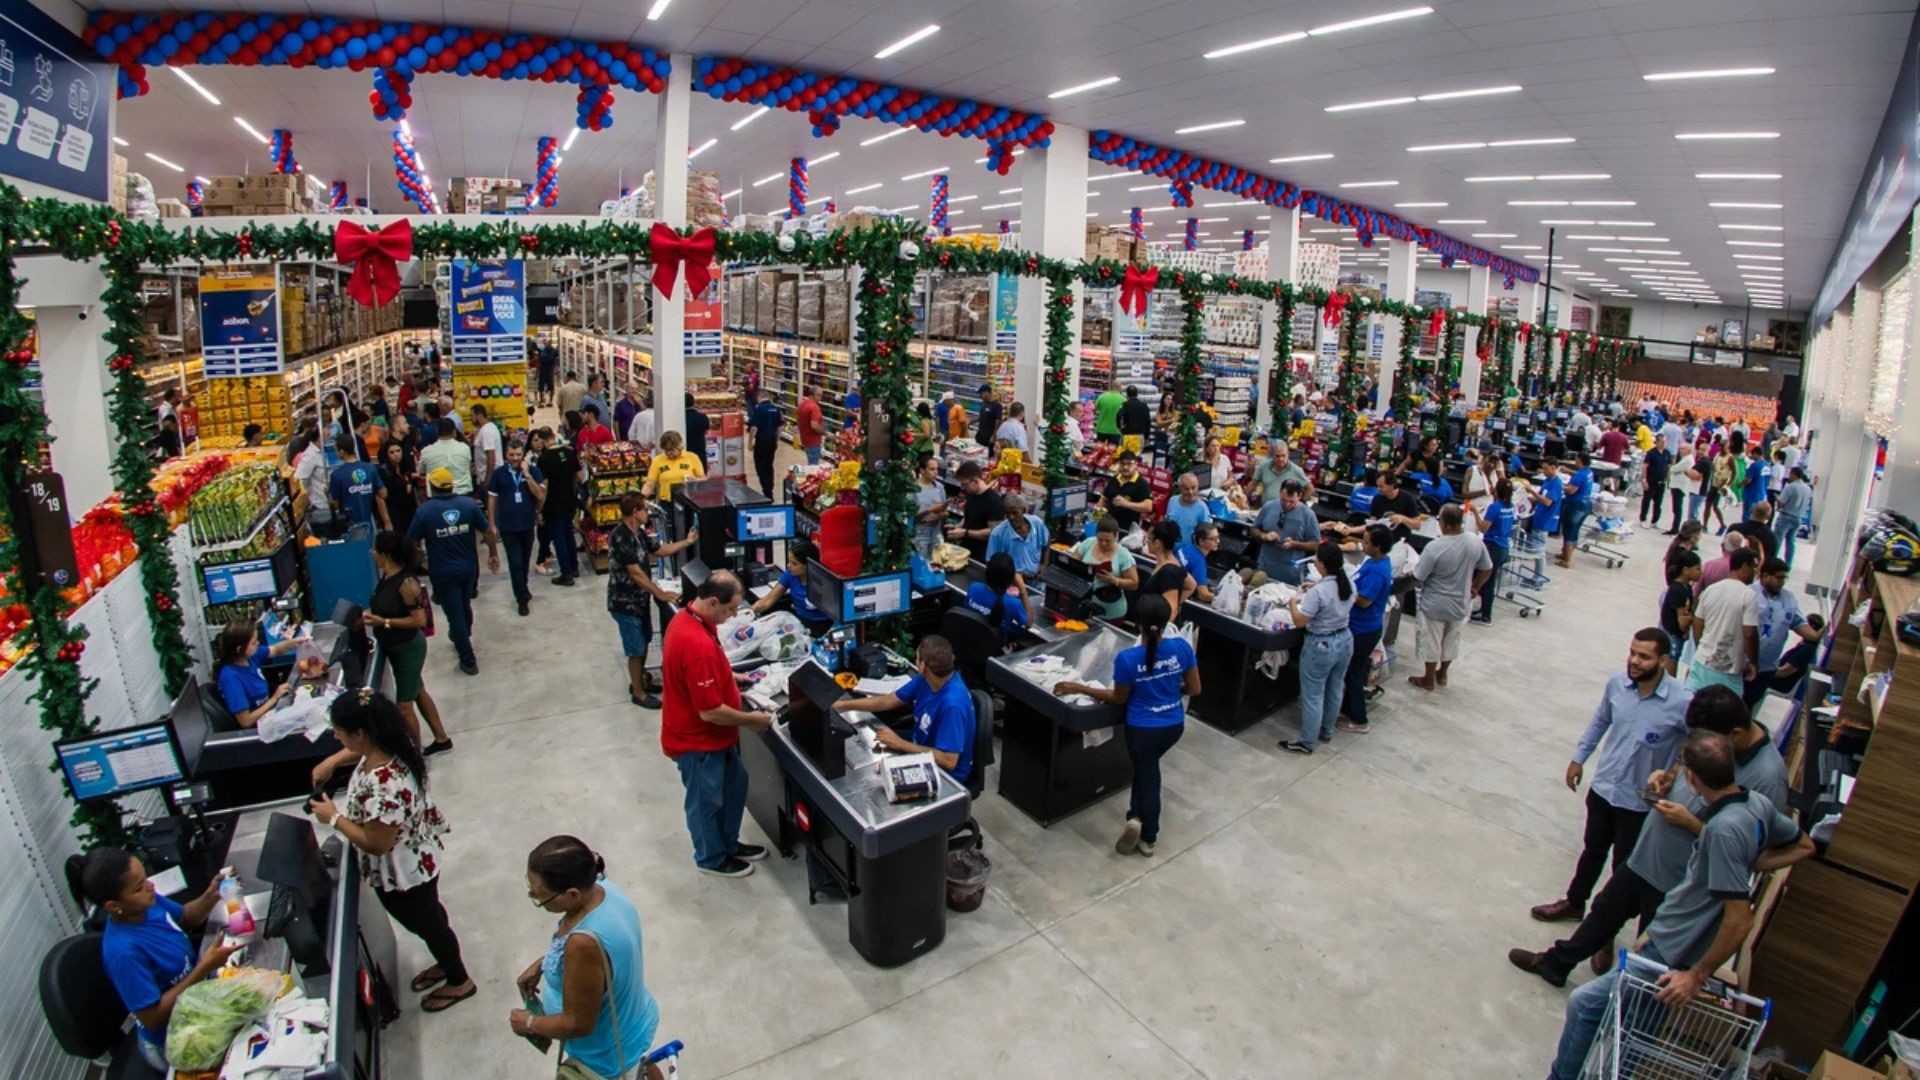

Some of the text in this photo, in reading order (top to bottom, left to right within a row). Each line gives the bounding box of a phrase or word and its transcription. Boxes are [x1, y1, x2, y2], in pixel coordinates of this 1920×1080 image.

[491, 295, 515, 303] IDEAL
[492, 303, 515, 311] PARA
[873, 404, 882, 414] 16
[31, 482, 46, 497] 18
[46, 497, 61, 512] 19
